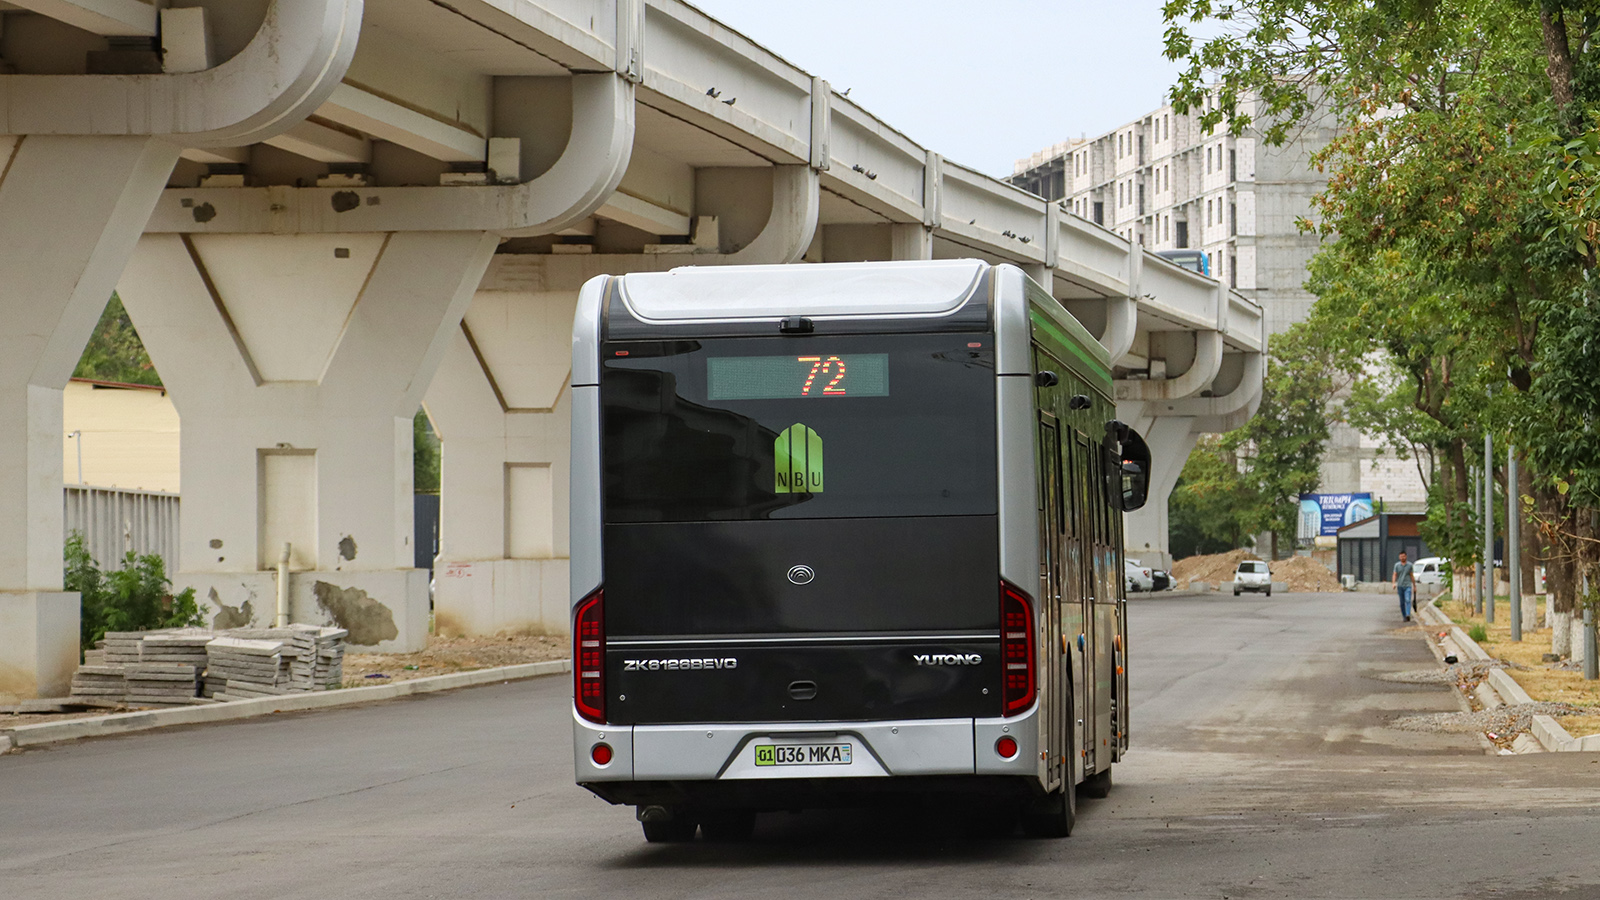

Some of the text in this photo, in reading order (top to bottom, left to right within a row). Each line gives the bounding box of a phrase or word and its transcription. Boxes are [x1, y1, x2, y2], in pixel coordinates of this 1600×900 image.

[798, 356, 846, 395] 72
[1319, 495, 1351, 504] TRIUMPH
[913, 654, 982, 666] YUTONG
[759, 746, 842, 763] 01 036 MKA
